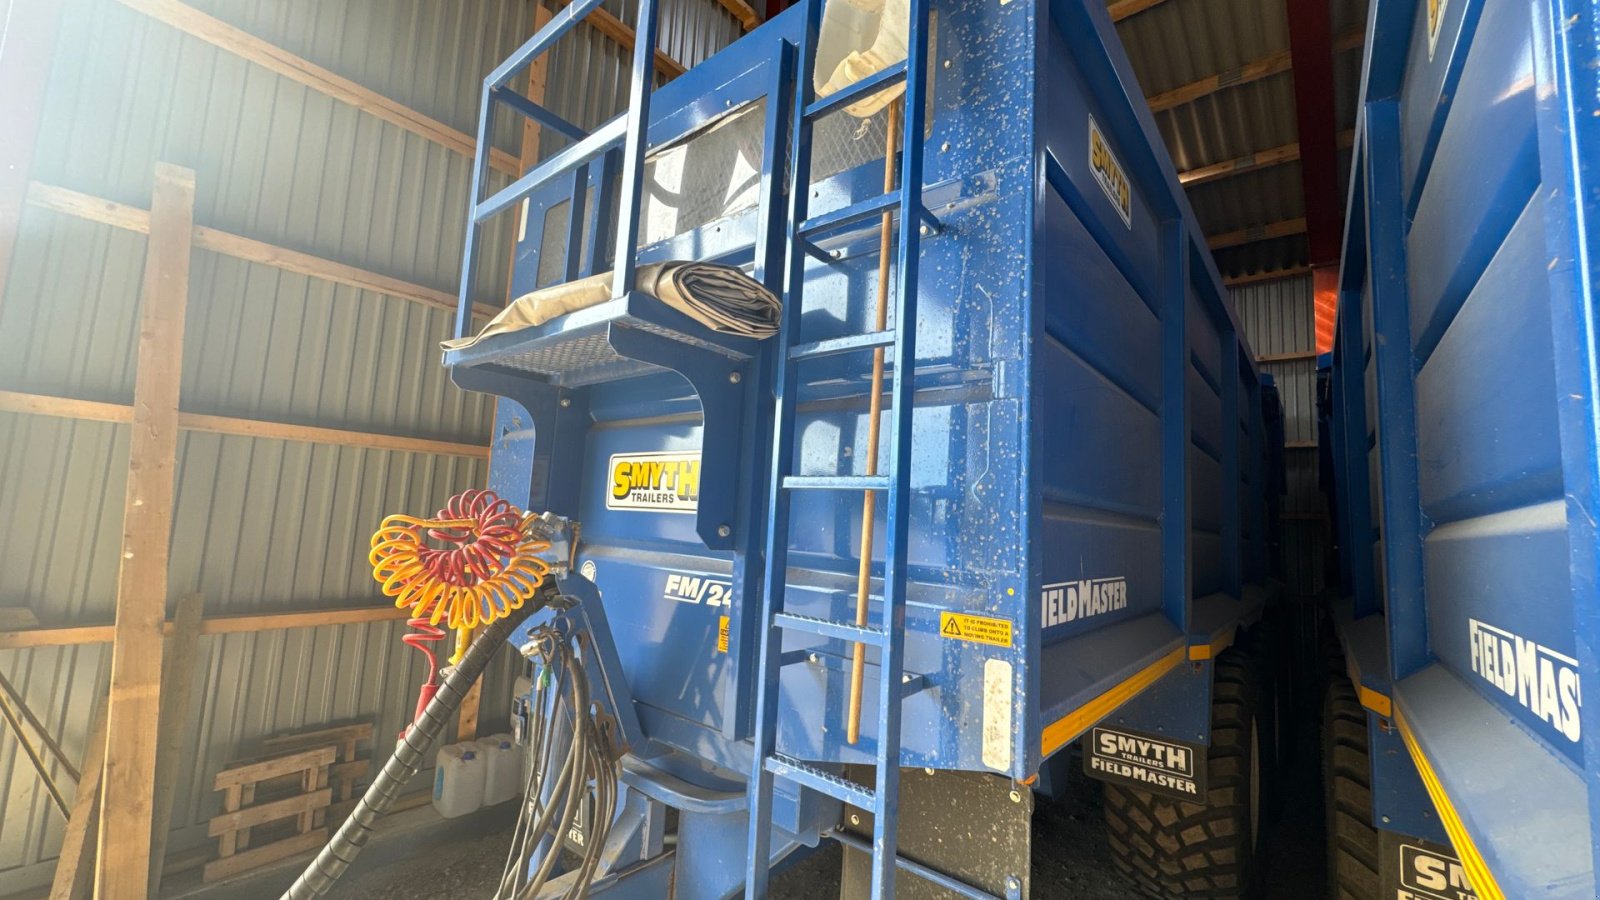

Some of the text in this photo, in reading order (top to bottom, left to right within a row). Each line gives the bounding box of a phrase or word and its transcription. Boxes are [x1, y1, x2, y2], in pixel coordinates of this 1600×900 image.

[1091, 128, 1129, 217] SMYTH
[613, 461, 699, 501] SMYTH
[631, 493, 674, 503] TRAILERS
[1041, 579, 1127, 629] IELDMASTER
[1100, 733, 1186, 771] SMYTH
[1121, 752, 1165, 768] TRAILERS
